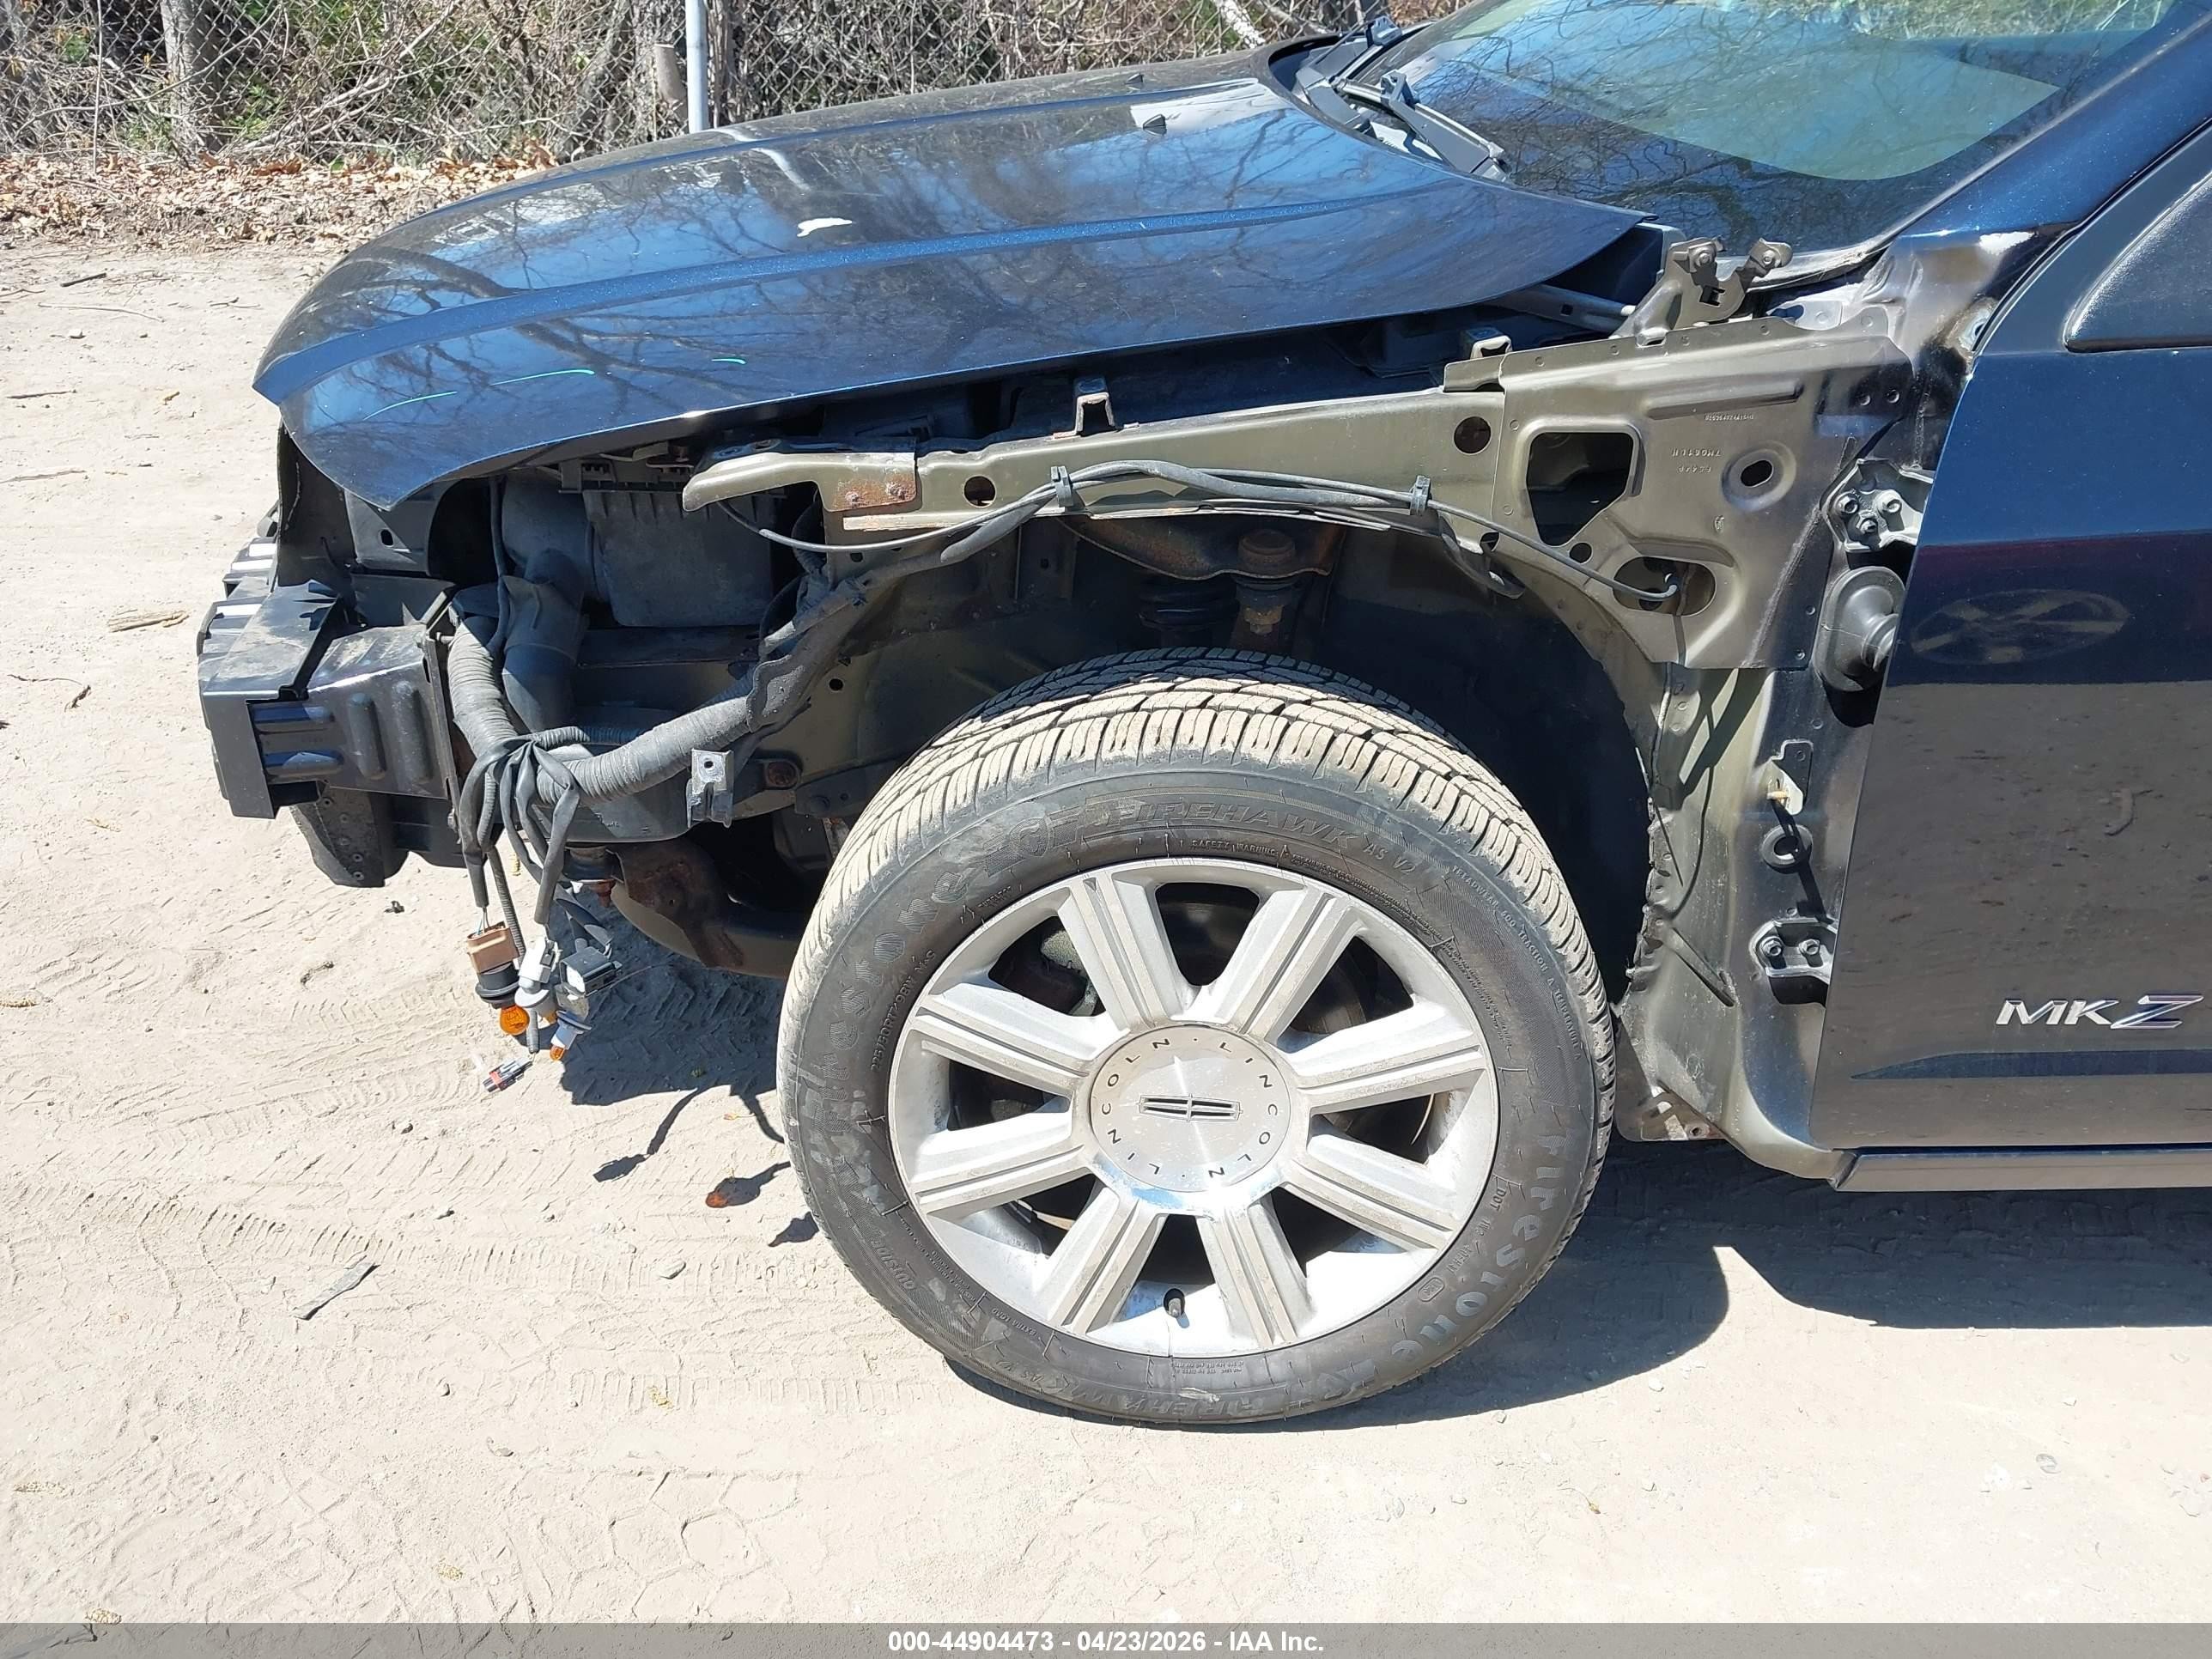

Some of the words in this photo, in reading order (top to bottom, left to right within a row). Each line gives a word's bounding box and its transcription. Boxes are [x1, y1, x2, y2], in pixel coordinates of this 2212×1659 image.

[1103, 804, 1359, 848] FIREHAWK
[1362, 840, 1390, 861] AS
[1390, 854, 1419, 877] V2
[1516, 930, 1549, 972] TRACTION
[1996, 994, 2204, 1030] MKZ
[1102, 1038, 1170, 1175] LINCOLN
[1208, 1042, 1279, 1178] LINCOLN
[1487, 1188, 1506, 1212] DOT
[1390, 1132, 1575, 1364] Firestone
